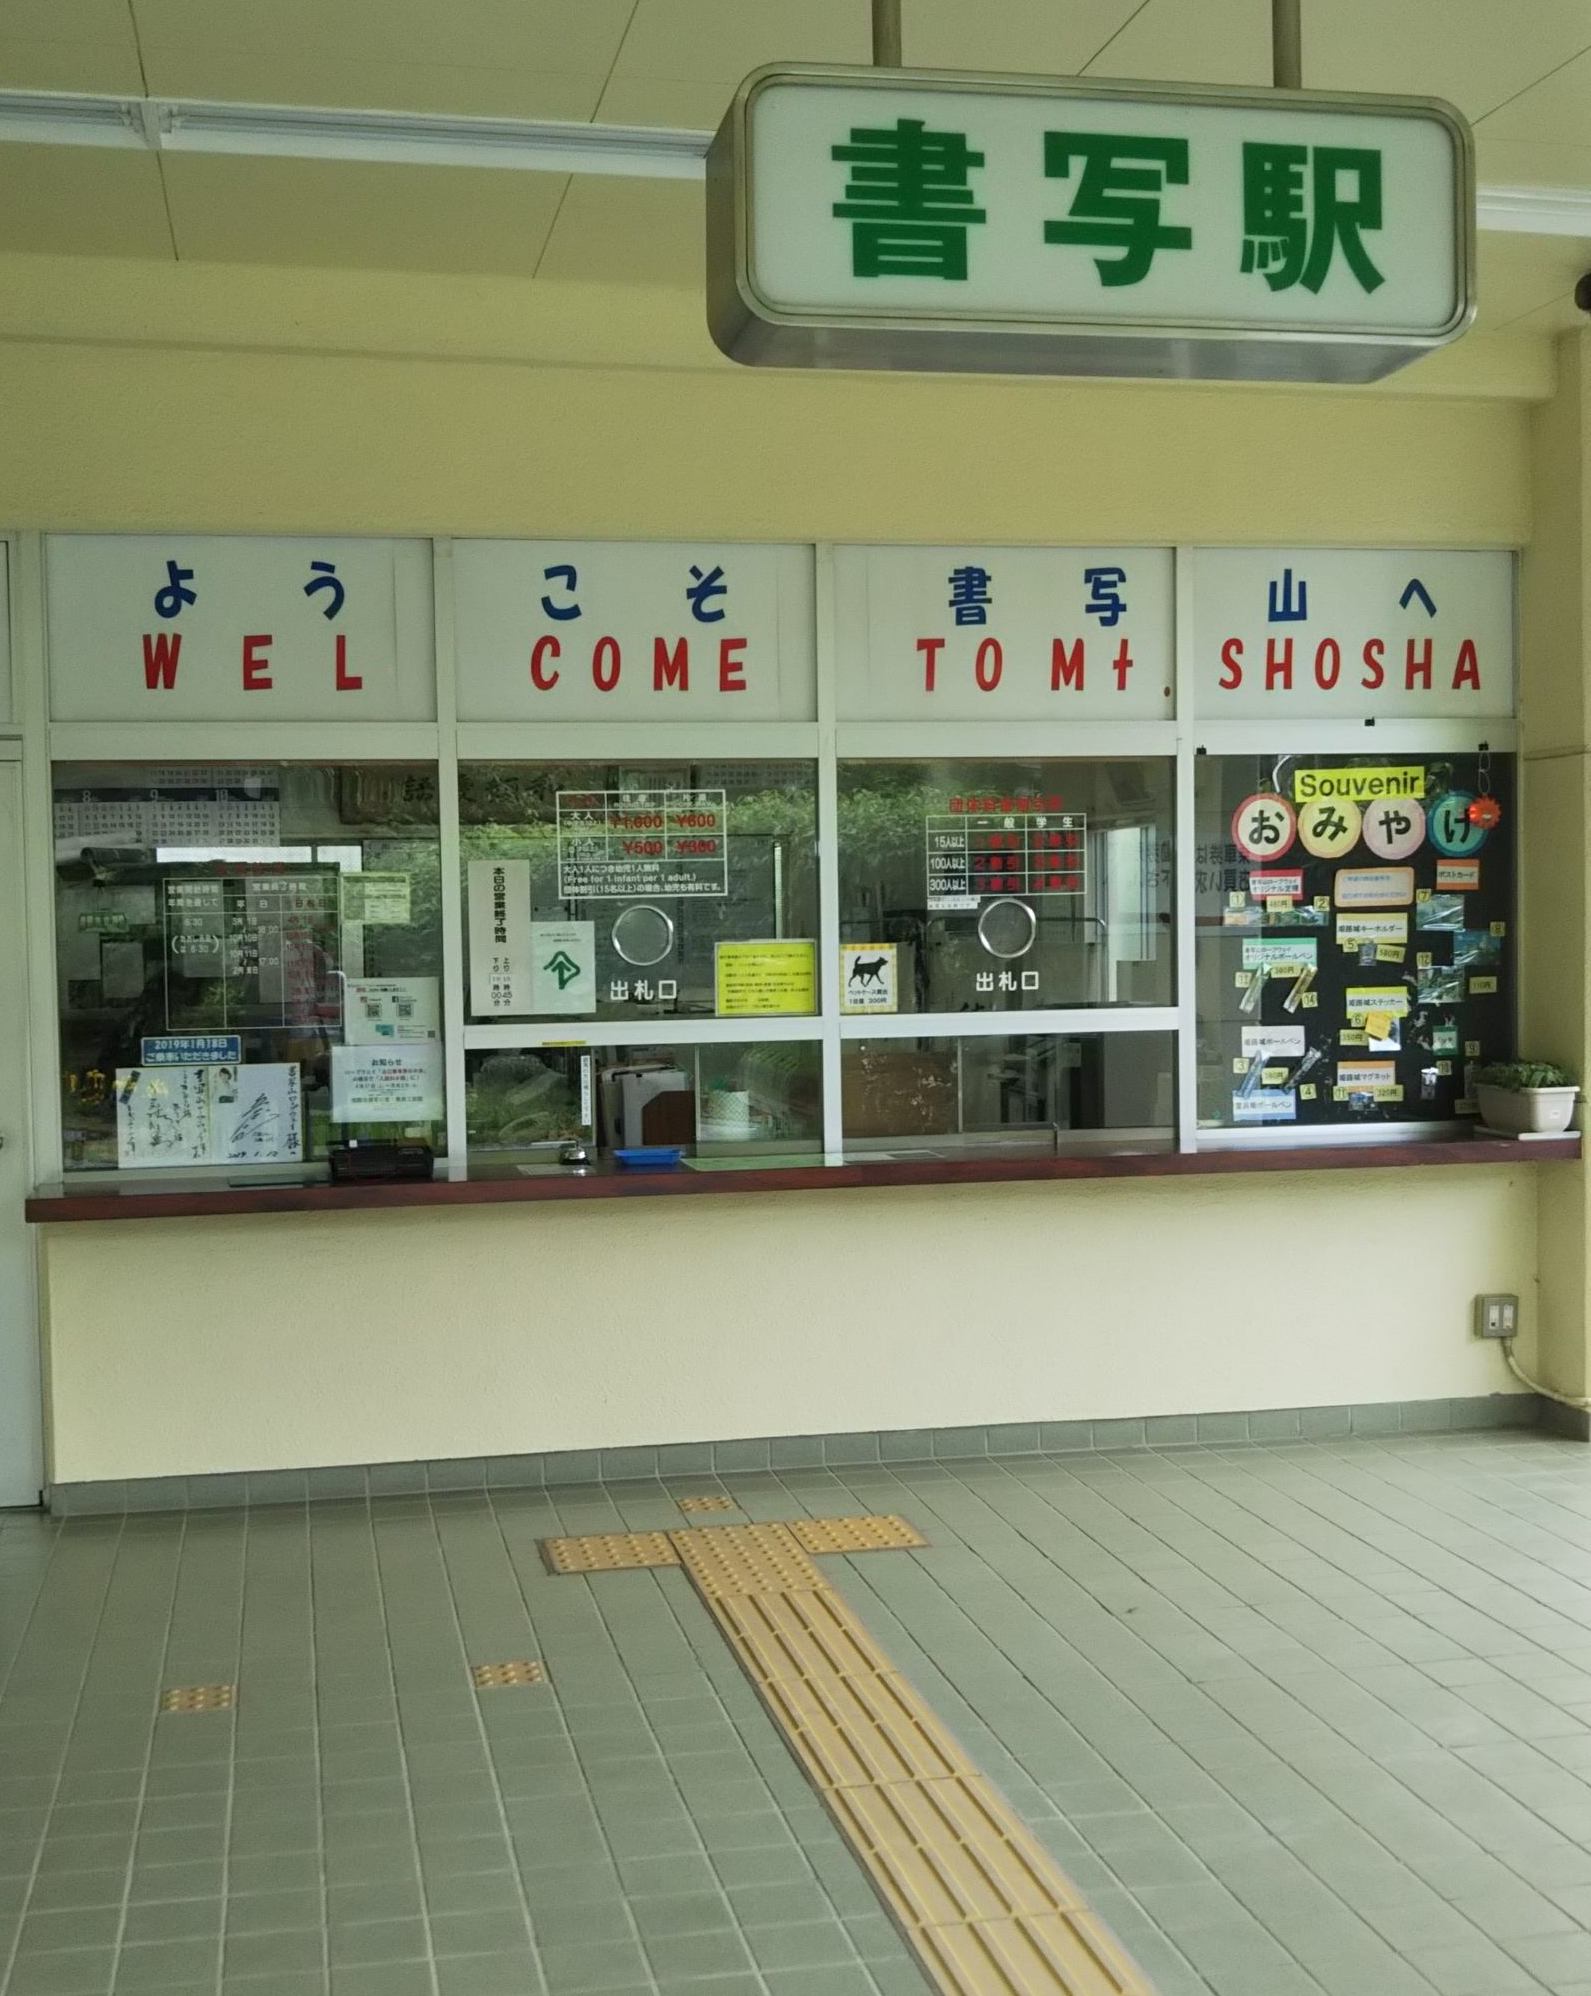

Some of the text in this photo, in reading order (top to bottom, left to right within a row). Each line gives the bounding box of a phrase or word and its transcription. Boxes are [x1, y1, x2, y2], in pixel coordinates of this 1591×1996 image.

[831, 117, 1387, 297] 書写駅
[1218, 637, 1481, 691] SHOSHA
[1299, 770, 1421, 797] Souvenir
[610, 979, 678, 1001] 出札口
[976, 971, 1040, 992] 出札口
